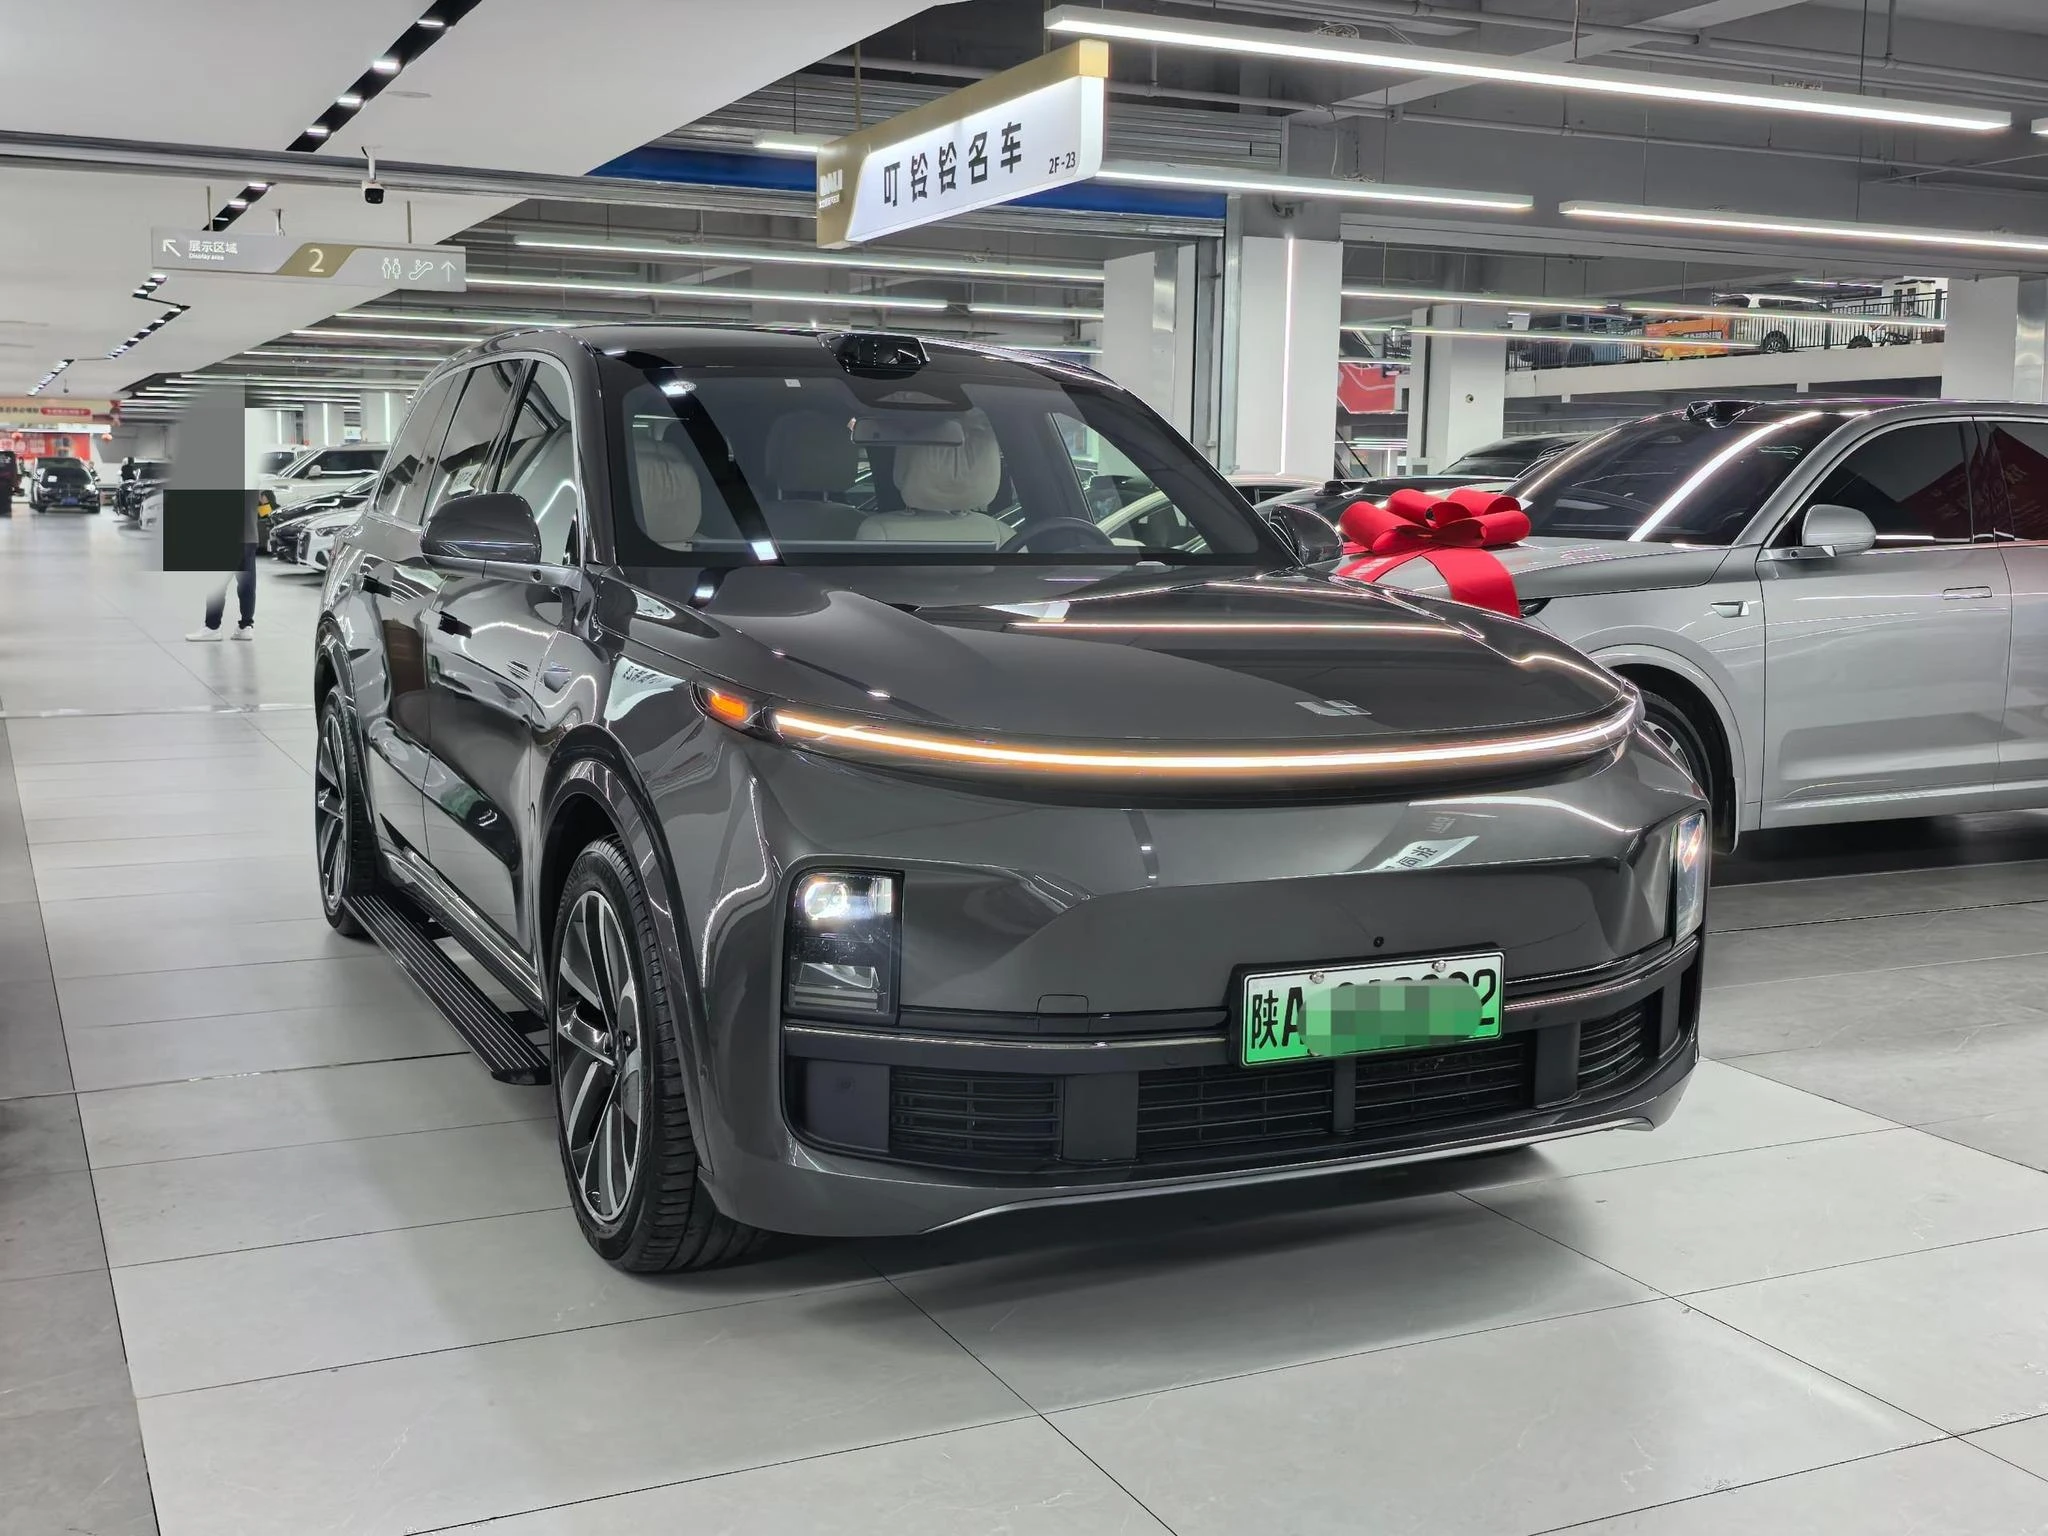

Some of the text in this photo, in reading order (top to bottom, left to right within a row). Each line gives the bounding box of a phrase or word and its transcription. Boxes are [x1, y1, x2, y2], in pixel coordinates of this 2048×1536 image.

[883, 121, 1022, 207] 叮铃铃名车
[1048, 151, 1076, 175] 2F-23
[188, 239, 238, 254] 展示区域
[308, 248, 325, 273] 2
